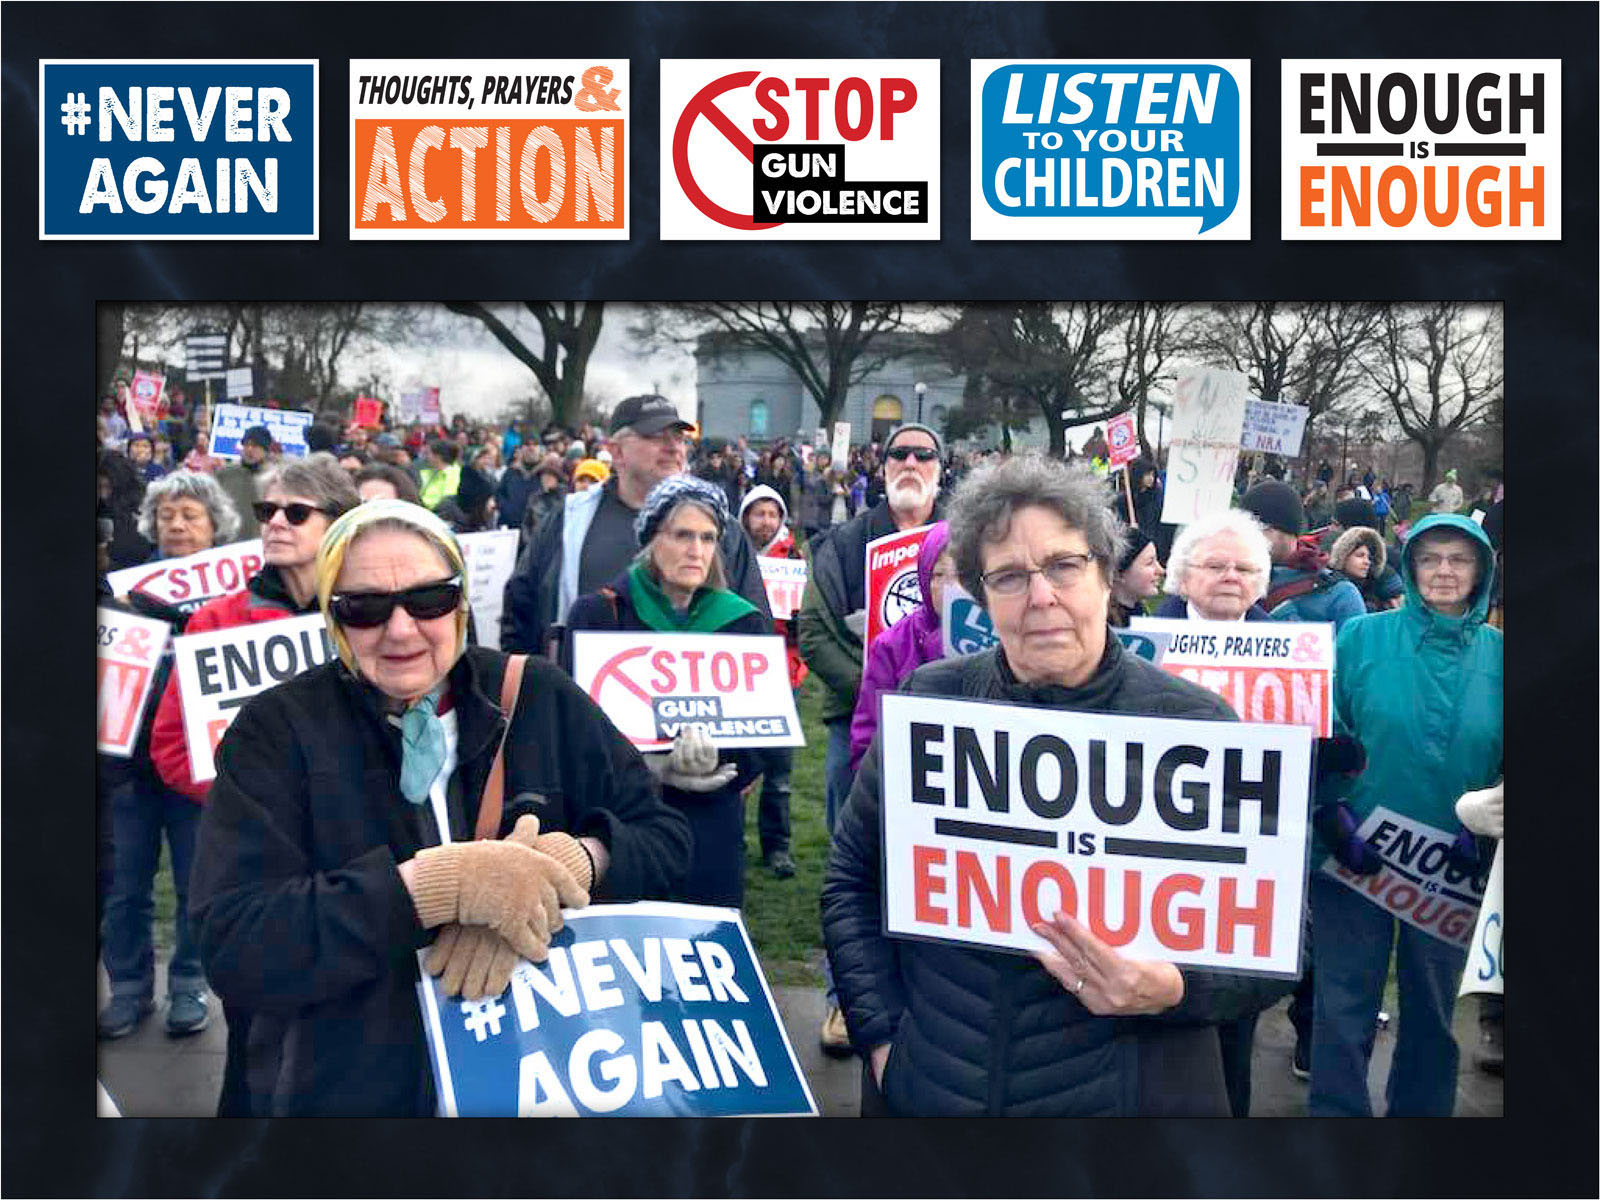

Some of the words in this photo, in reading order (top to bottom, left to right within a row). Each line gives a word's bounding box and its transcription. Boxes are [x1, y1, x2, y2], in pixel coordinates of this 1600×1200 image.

[167, 554, 262, 599] STOP
[1224, 636, 1291, 658] PRAYERS
[651, 650, 769, 693] STOP
[658, 700, 718, 718] GUN
[910, 722, 1282, 836] ENOUGH
[1068, 831, 1096, 856] IS
[913, 844, 1276, 958] ENOUGH
[461, 938, 750, 1043] #NEVER
[518, 1019, 768, 1118] AGAIN
